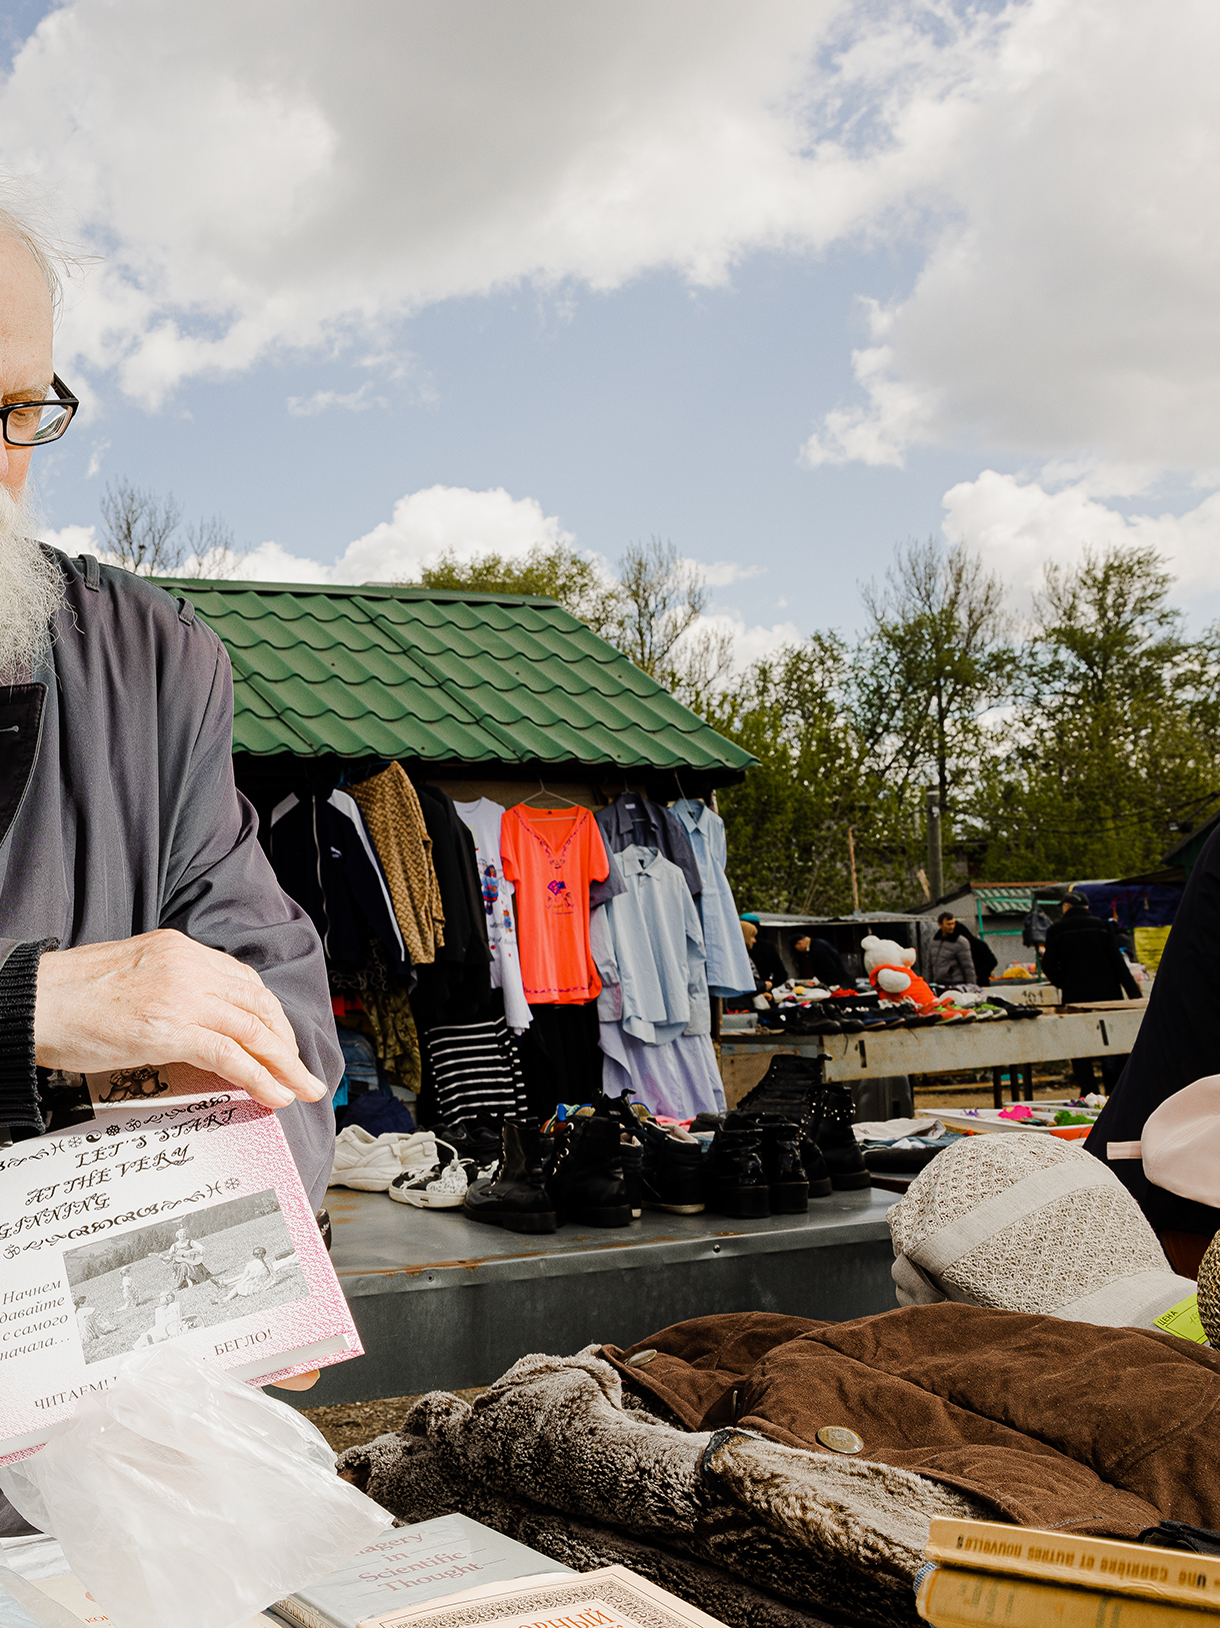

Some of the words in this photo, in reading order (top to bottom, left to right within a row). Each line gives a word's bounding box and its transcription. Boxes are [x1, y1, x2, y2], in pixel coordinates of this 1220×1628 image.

[75, 1135, 149, 1169] LET'S
[154, 1107, 238, 1143] START
[25, 1183, 59, 1206] AT
[63, 1167, 112, 1195] THE
[115, 1143, 195, 1179] VERY
[2, 1279, 62, 1306] Начнем
[0, 1296, 66, 1325] давайте
[1157, 1311, 1179, 1326] ЦЕНА
[2, 1331, 11, 1342] с
[14, 1313, 69, 1339] самого
[213, 1328, 273, 1357] БЕГЛО!
[357, 1549, 468, 1583] Scientific
[385, 1549, 409, 1564] in
[377, 1559, 485, 1593] Thought
